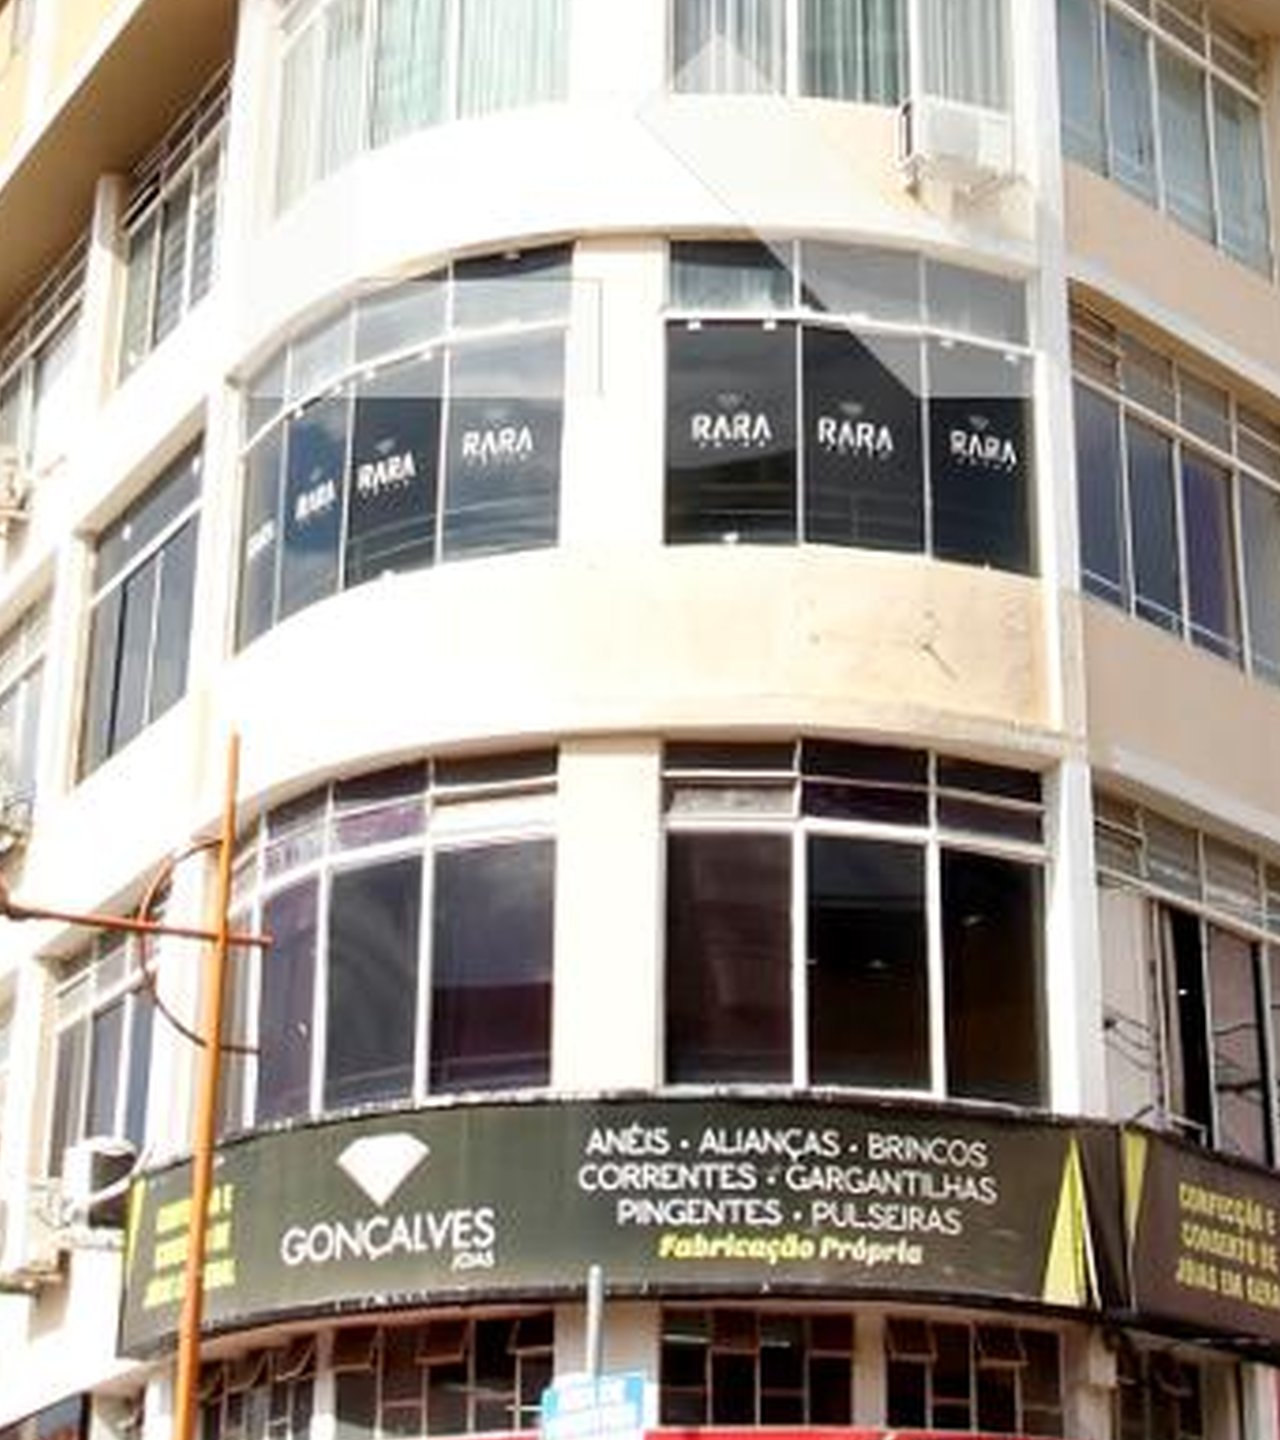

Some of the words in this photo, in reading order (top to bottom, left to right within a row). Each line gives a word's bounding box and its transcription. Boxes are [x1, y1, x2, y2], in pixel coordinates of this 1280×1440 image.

[462, 425, 533, 458] RARA
[691, 414, 772, 440] RARA
[819, 418, 893, 451] RARA
[950, 430, 1016, 466] RARA
[357, 452, 416, 490] RARA
[585, 1123, 671, 1156] ANÉIS
[699, 1127, 841, 1162] ALIANÇAS
[867, 1132, 990, 1168] BRINCOS
[578, 1163, 758, 1192] CORRENTES
[785, 1166, 998, 1204] GARGANTILHAS
[618, 1198, 782, 1226] PINGENTES
[811, 1201, 963, 1236] PULSEIRAS
[281, 1208, 496, 1266] GONÇALVES
[658, 1233, 814, 1264] Fabricação
[819, 1234, 923, 1267] Própria
